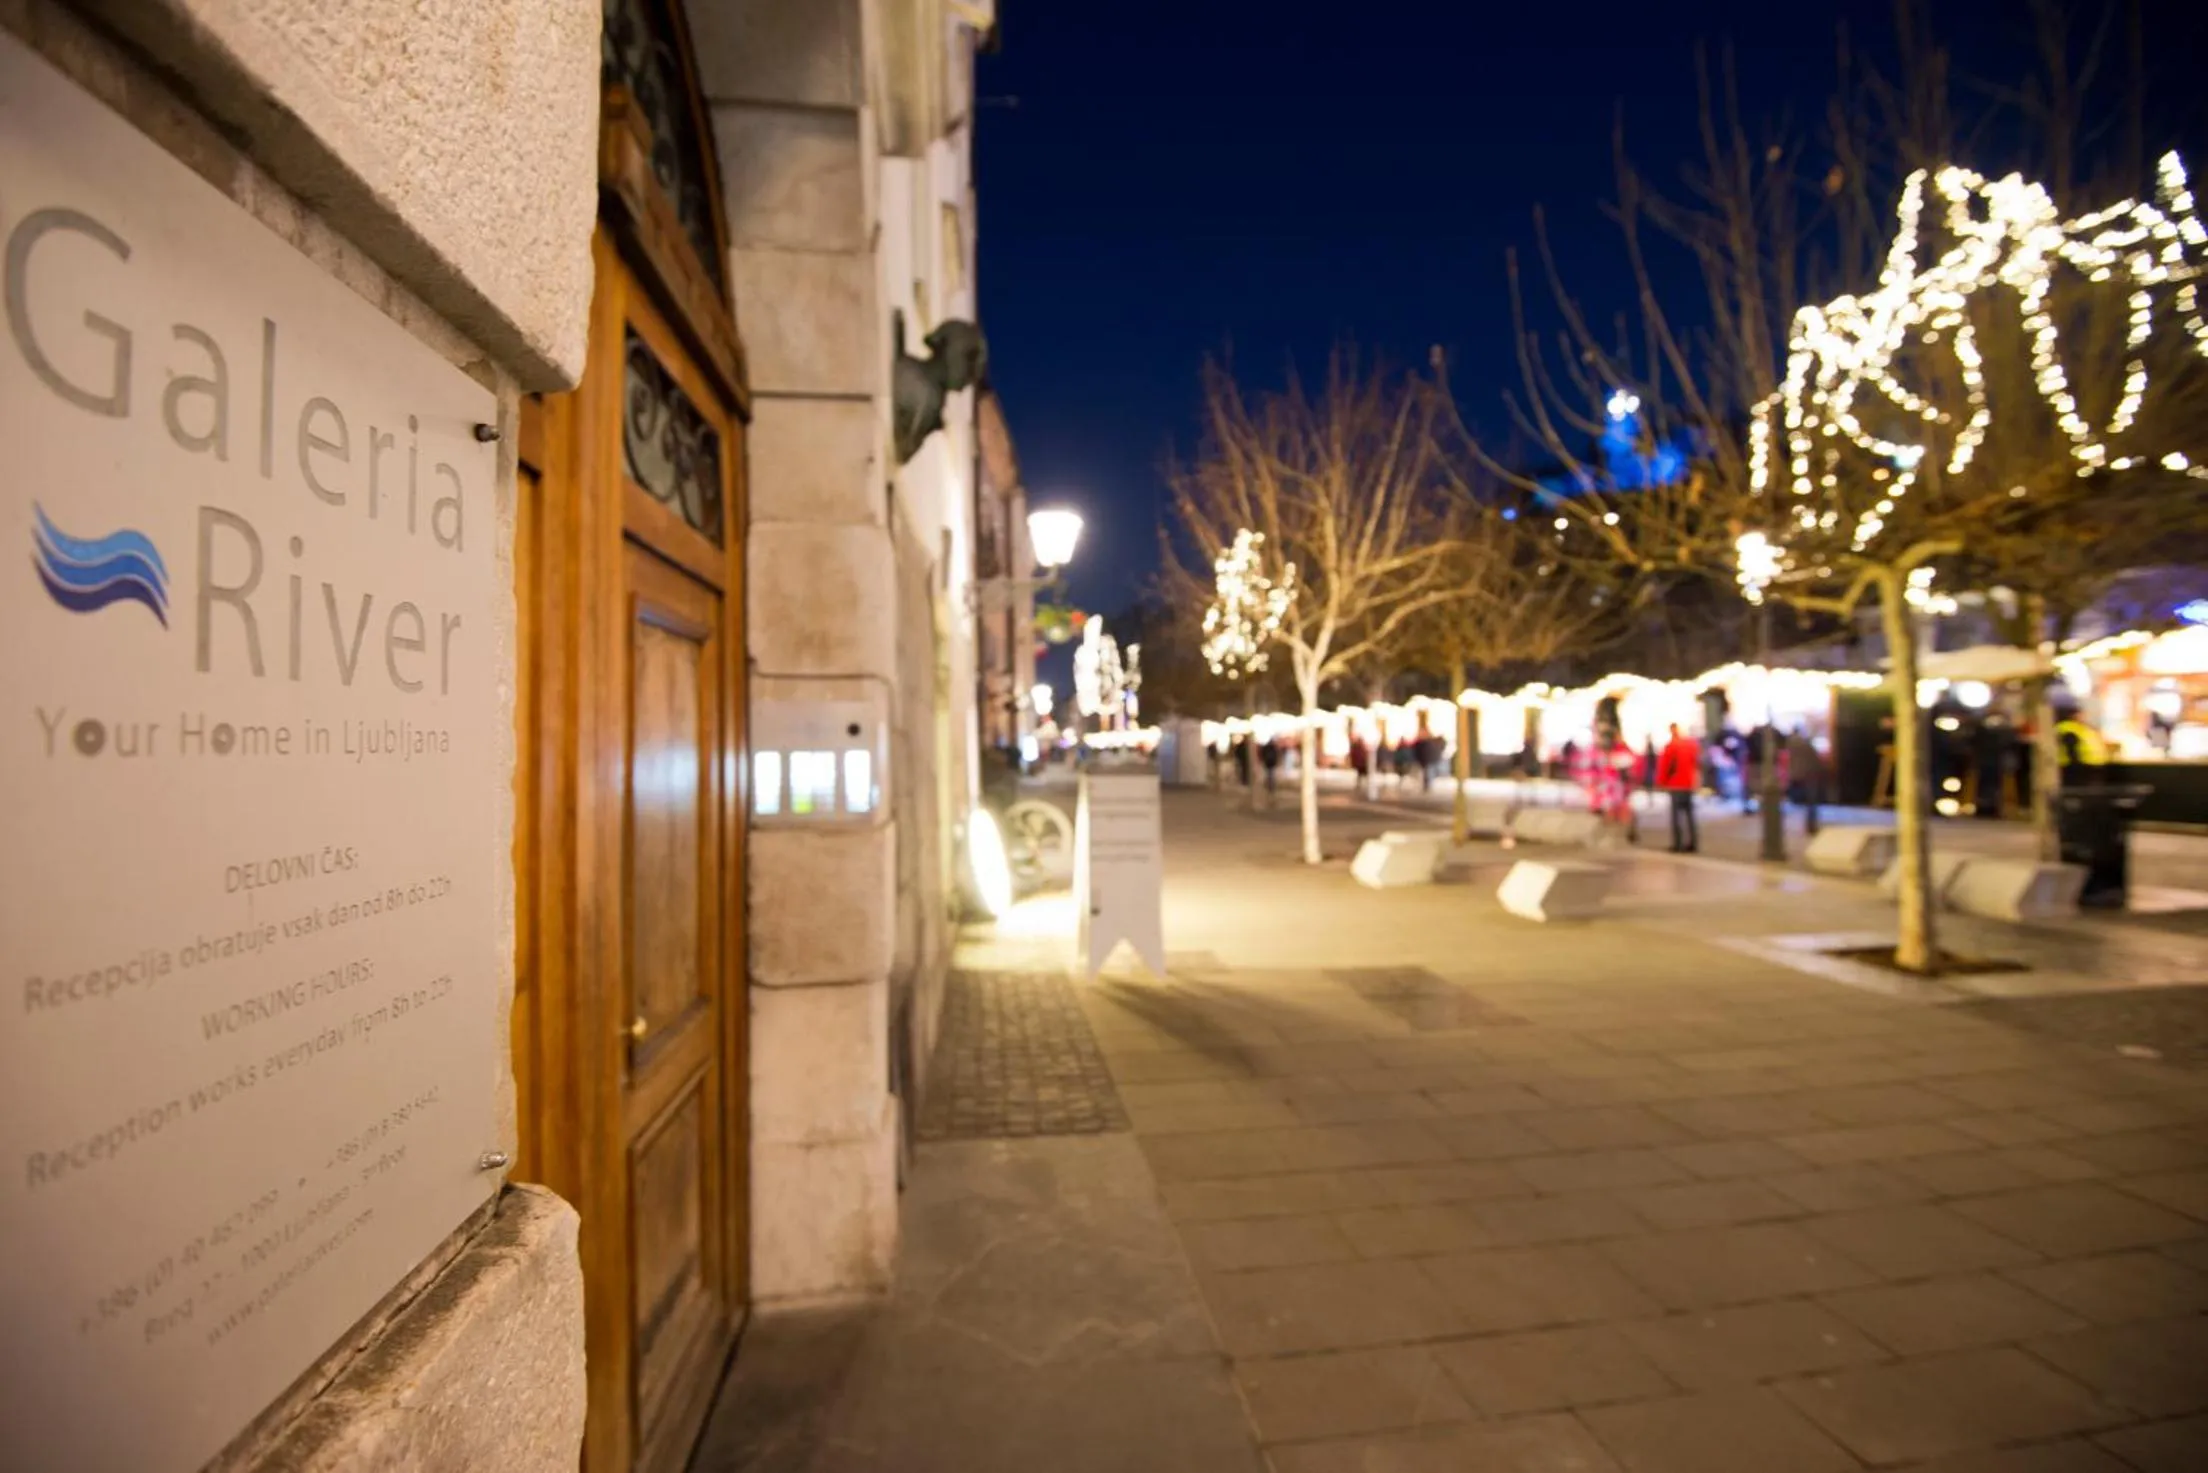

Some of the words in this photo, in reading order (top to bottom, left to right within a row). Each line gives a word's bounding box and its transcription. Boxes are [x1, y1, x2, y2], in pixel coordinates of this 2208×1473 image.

[3, 207, 465, 553] Galeria
[195, 504, 462, 696] River
[35, 706, 160, 758] Your
[179, 711, 292, 756] Home
[304, 718, 330, 755] in
[343, 718, 450, 764] Ljubljana
[224, 853, 315, 894] DELOVNI
[321, 846, 359, 874] ČAS:
[24, 947, 173, 1016] Recepcija
[179, 921, 277, 968] obratuje
[282, 906, 323, 938] vsak
[328, 900, 360, 927] dan
[362, 891, 383, 918] od
[200, 980, 306, 1041] WORKING
[311, 957, 374, 1000] HOURS:
[25, 1098, 182, 1193] Reception
[188, 1063, 257, 1113] works
[263, 1022, 347, 1078] everyday
[352, 1005, 388, 1037] from
